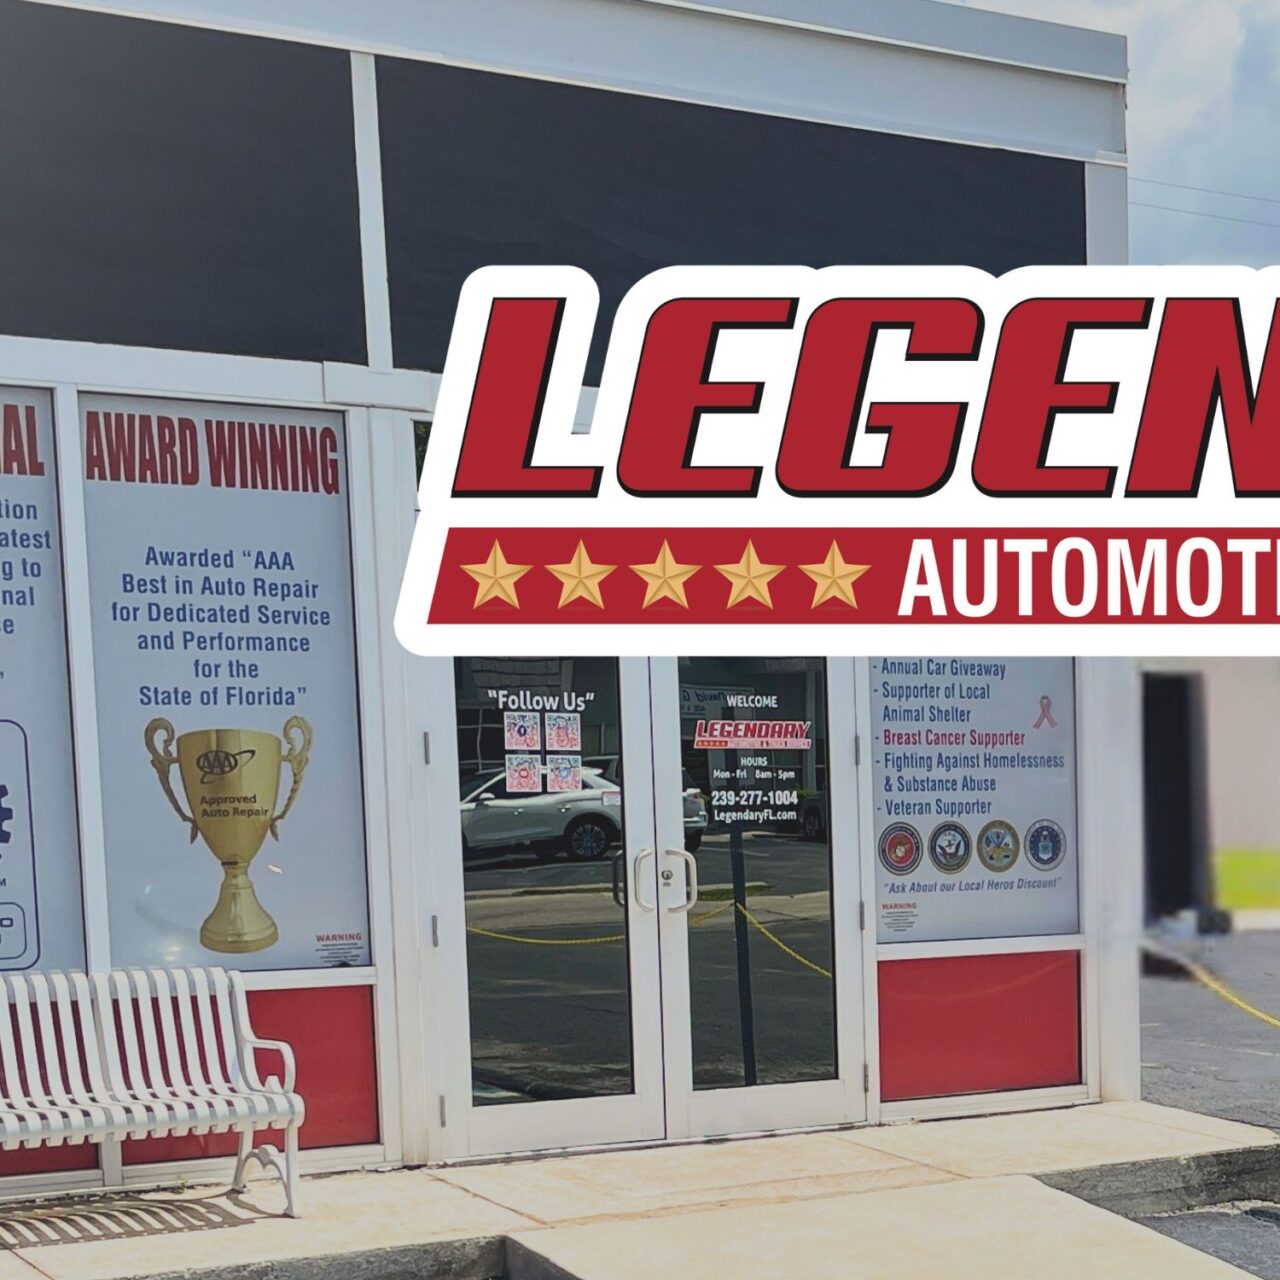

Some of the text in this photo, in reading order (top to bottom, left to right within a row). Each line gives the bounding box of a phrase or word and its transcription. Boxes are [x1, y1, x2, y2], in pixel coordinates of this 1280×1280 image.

[86, 410, 340, 495] AWARD WINNING
[145, 546, 234, 569] Awarded
[22, 558, 41, 577] to
[122, 574, 319, 601] Best in Auto Repair
[112, 602, 331, 626] for Dedicated Service
[138, 631, 310, 653] and Performance
[194, 659, 259, 679] for the
[881, 658, 922, 676] Annual
[926, 659, 947, 676] Car
[951, 659, 1006, 681] Giveaway
[139, 686, 192, 706] State
[200, 686, 218, 706] of
[726, 695, 778, 708] WELCOME
[882, 682, 941, 703] Supporter
[944, 683, 956, 699] of
[959, 683, 990, 700] Local
[882, 706, 971, 723] Animal Shelter
[696, 720, 811, 740] LEGENDARY
[883, 729, 921, 746] Breast
[925, 729, 965, 746] Cancer
[970, 729, 1025, 750] Supporter
[740, 757, 768, 767] HOURS
[884, 752, 933, 772] Fighting
[936, 752, 980, 772] Against
[983, 753, 1065, 768] Homelessness
[713, 769, 731, 779] Mon
[736, 769, 747, 779] Fri
[778, 770, 795, 781] 5pm
[884, 776, 997, 792] & Substance Abuse
[200, 794, 257, 806] Approved
[711, 790, 799, 806] 239-277-1004
[201, 807, 269, 818] Auto Repair
[714, 809, 797, 823] LegendaryFL.com
[885, 799, 931, 816] Veteran
[935, 799, 992, 819] Supporter
[909, 881, 937, 893] About
[940, 882, 956, 892] our
[959, 880, 984, 892] Local
[987, 879, 1014, 891] Heros
[882, 902, 918, 911] WARNING
[315, 932, 362, 943] WARNING
